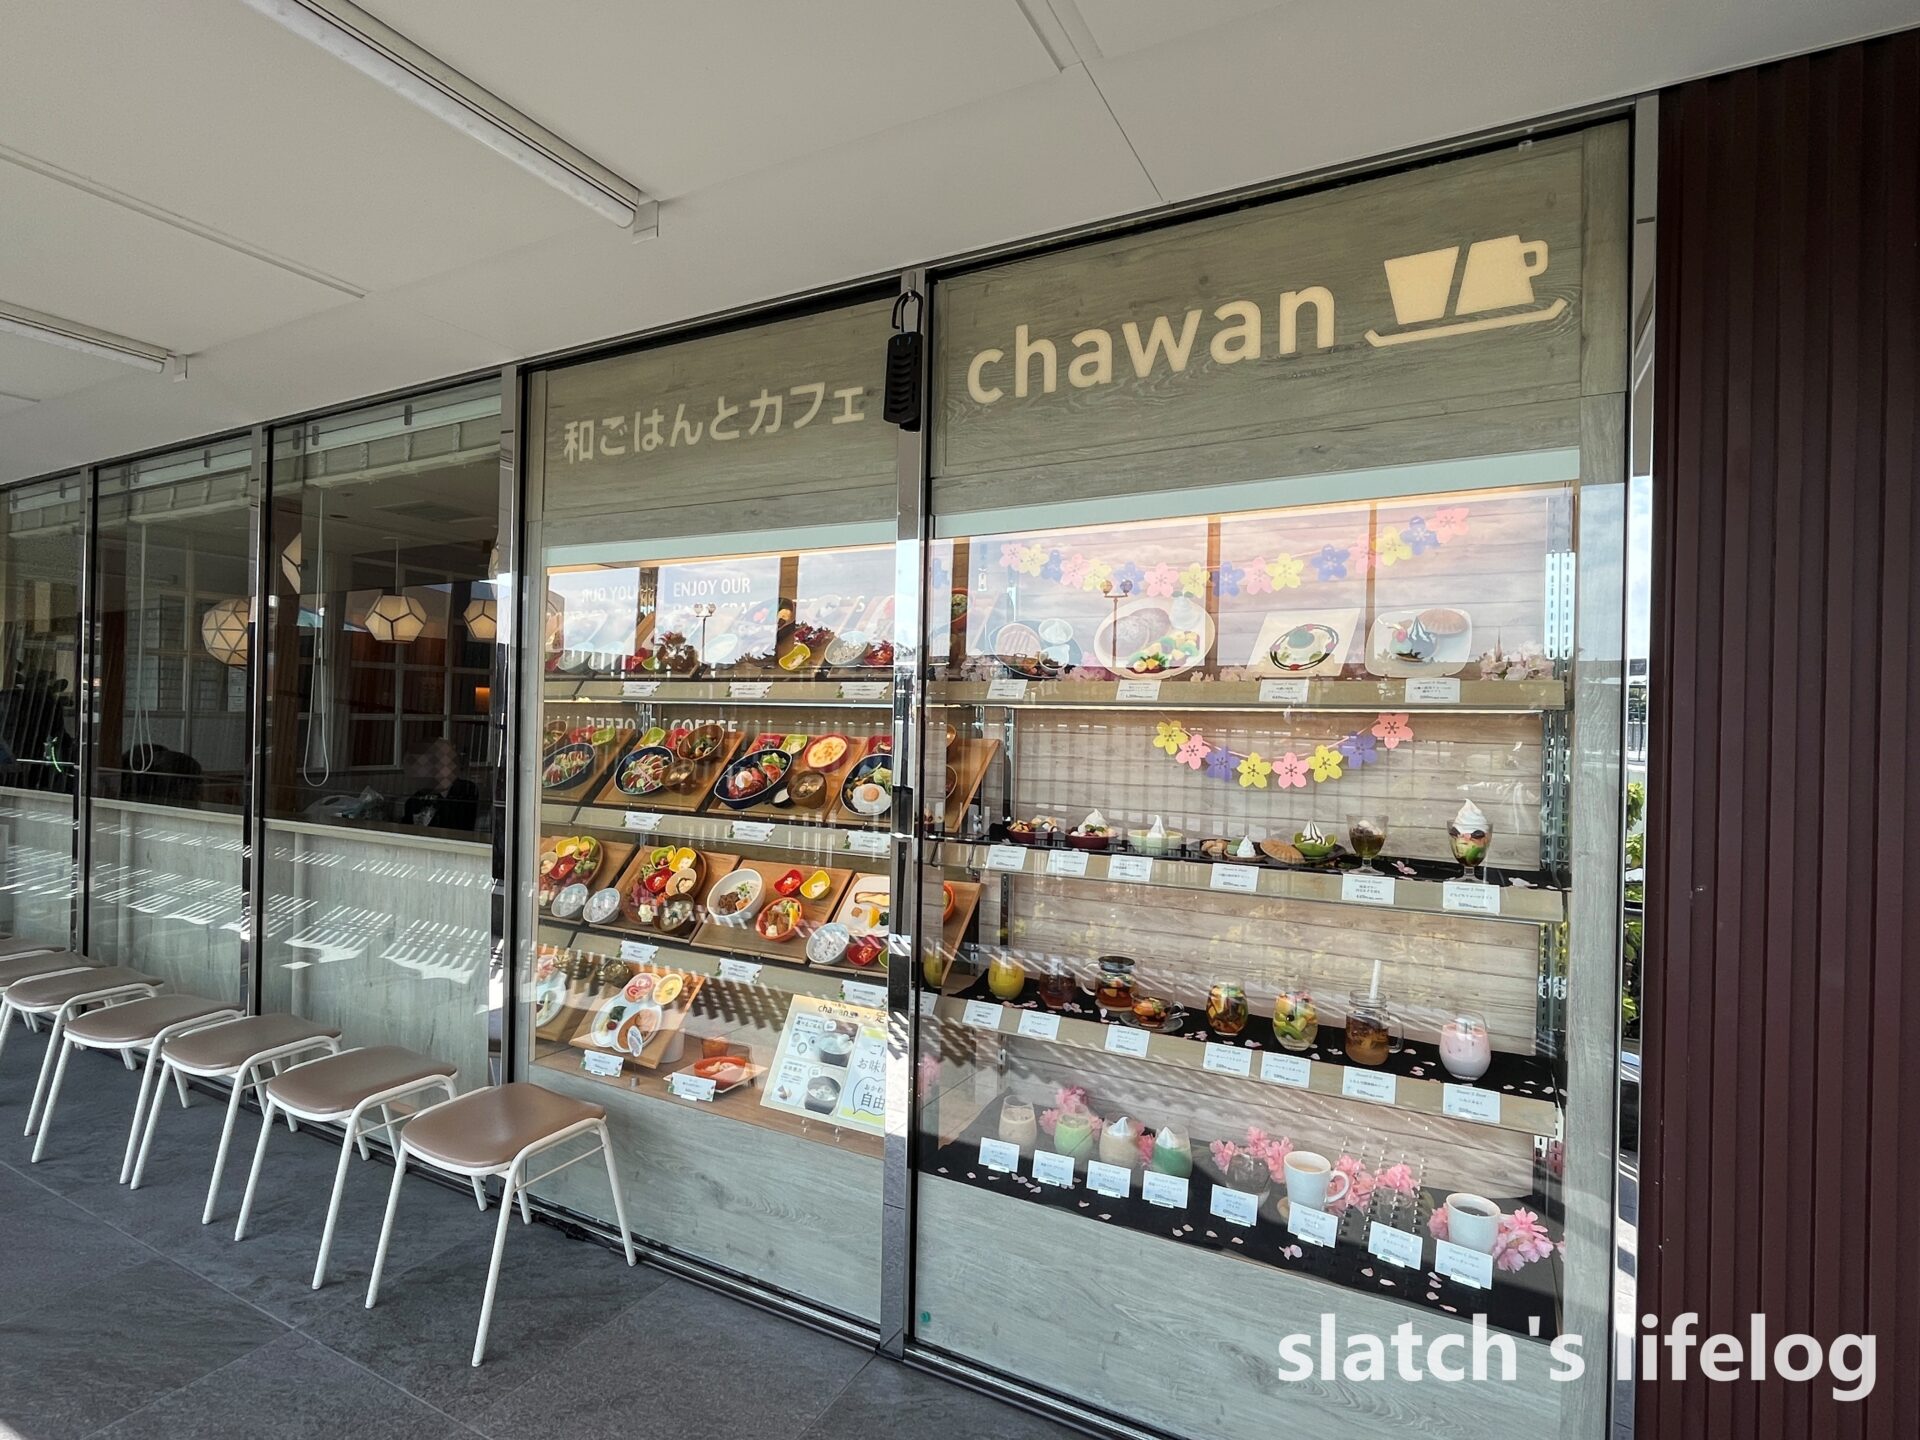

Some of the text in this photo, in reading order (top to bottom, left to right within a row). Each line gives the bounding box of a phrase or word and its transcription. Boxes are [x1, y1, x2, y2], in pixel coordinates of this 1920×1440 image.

[967, 285, 1336, 404] chawan
[563, 381, 865, 464] 和ごはんとカフェ
[673, 577, 751, 598] ENJOY OUR
